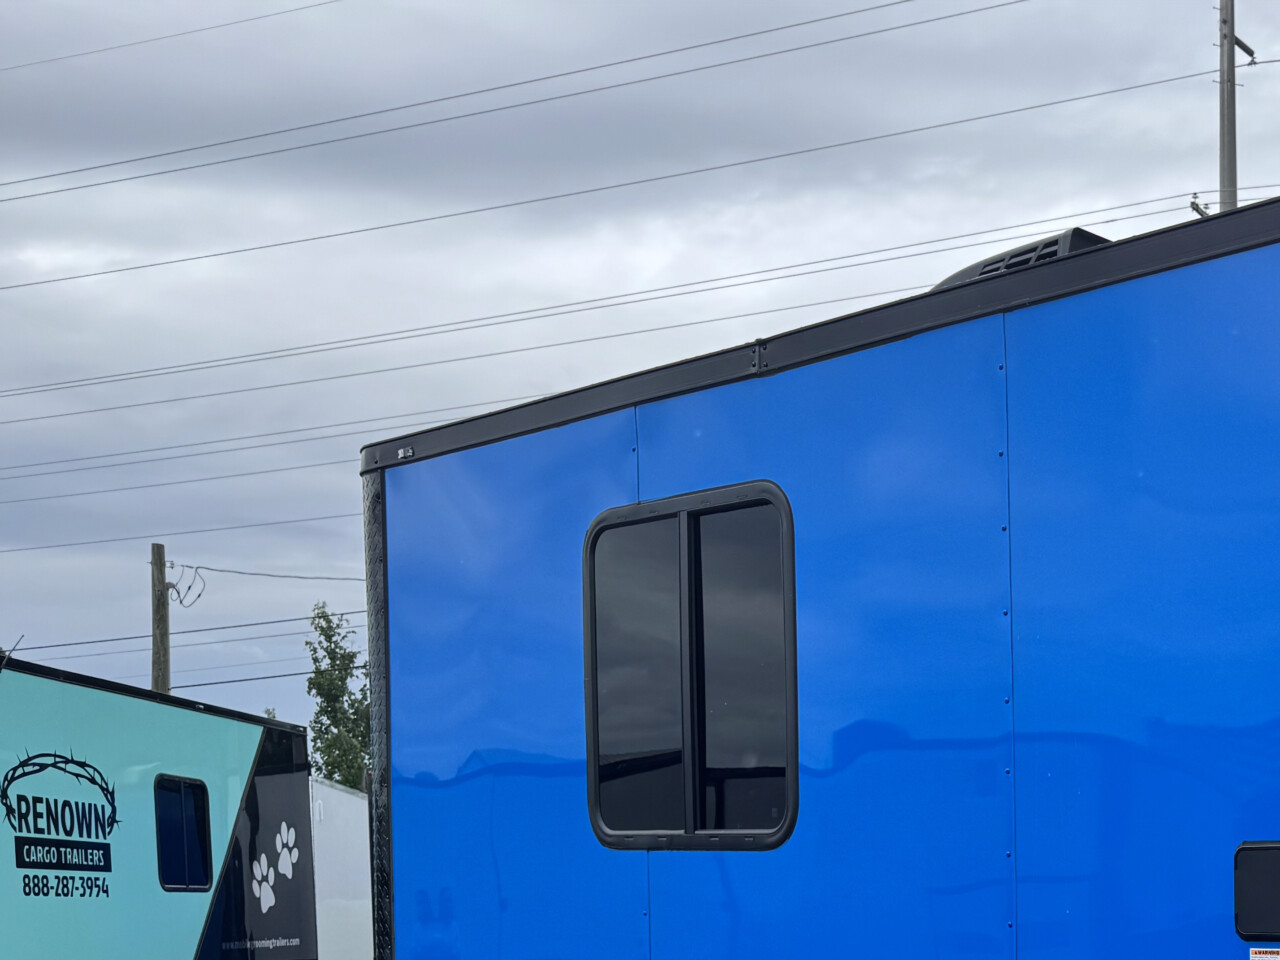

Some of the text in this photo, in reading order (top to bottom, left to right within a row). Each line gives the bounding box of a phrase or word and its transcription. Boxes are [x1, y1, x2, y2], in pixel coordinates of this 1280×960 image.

[16, 794, 107, 840] RENOWN
[23, 845, 105, 866] CARGO TRAILERS
[22, 873, 110, 898] 888-287-3954
